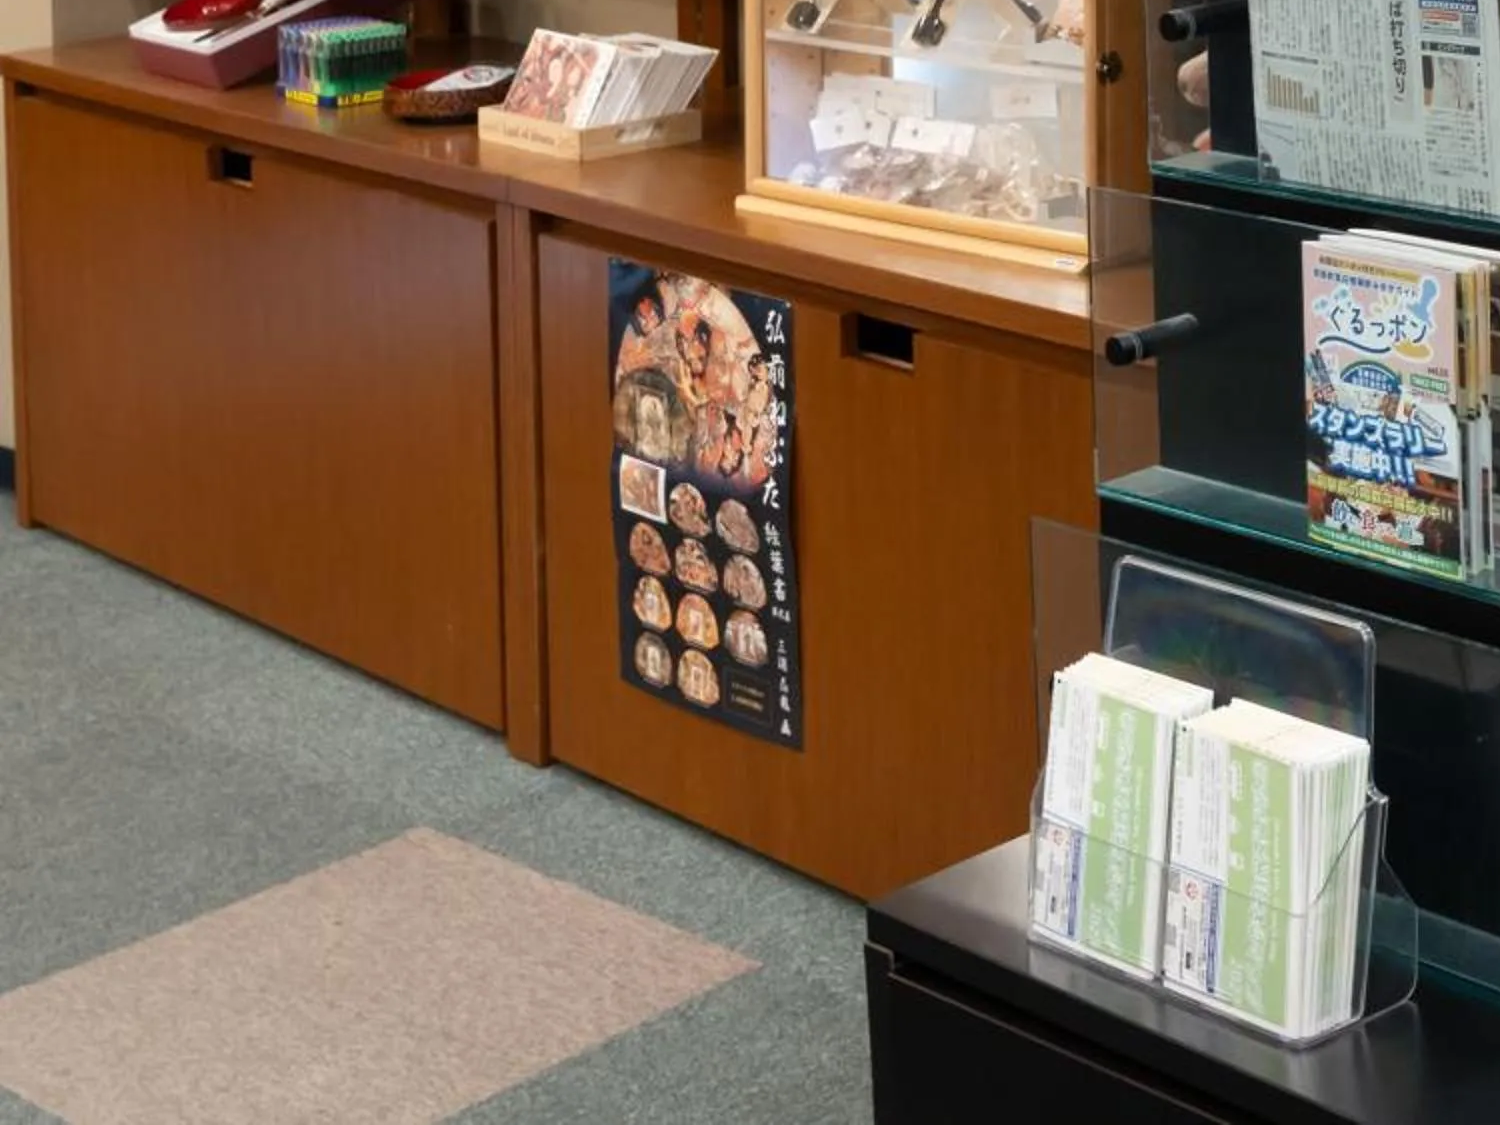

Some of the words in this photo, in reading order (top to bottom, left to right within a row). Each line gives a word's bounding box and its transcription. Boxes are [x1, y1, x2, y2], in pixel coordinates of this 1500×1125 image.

[1329, 306, 1430, 343] ぐるっポン
[763, 310, 786, 510] 弘前ねぷた
[1308, 405, 1447, 455] スタンプラリー
